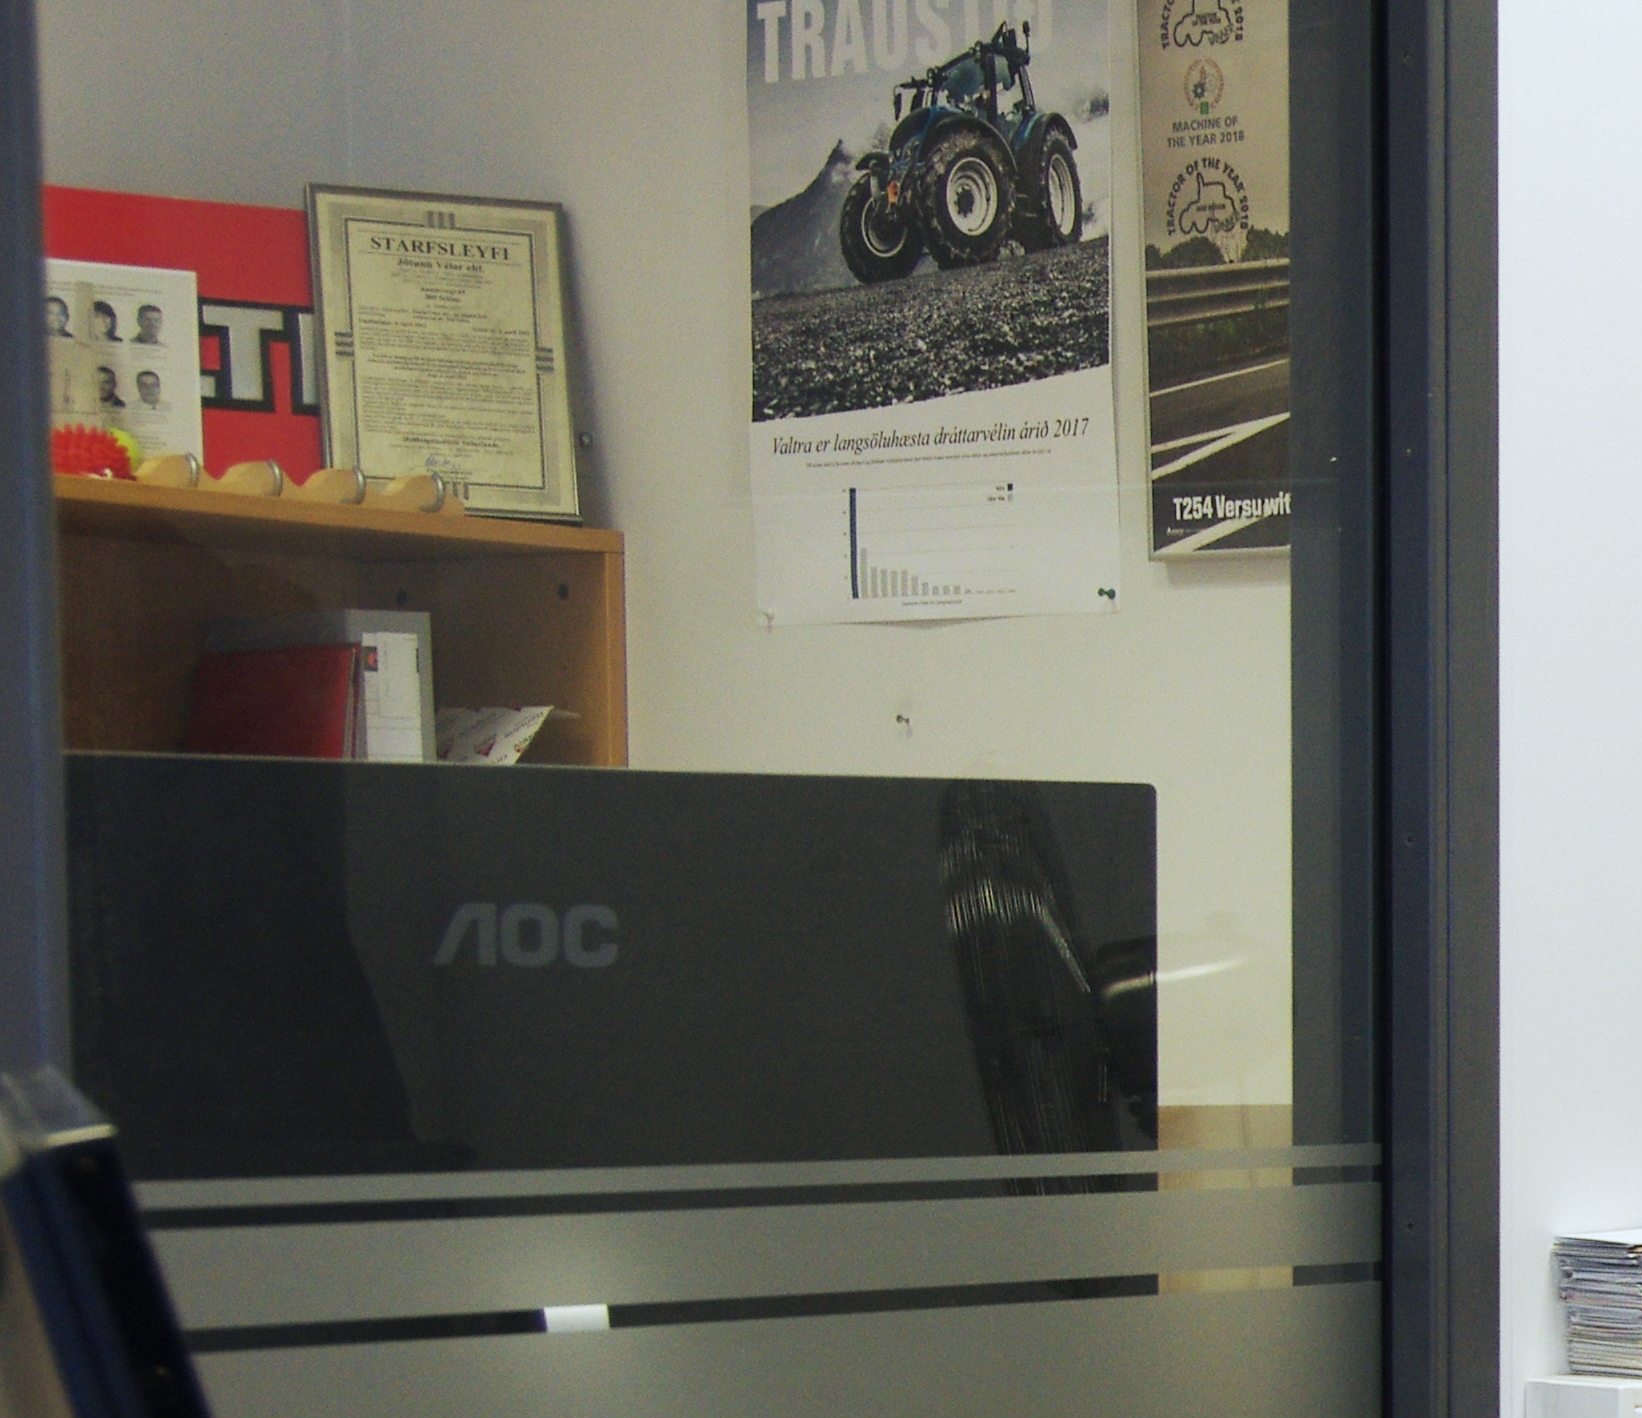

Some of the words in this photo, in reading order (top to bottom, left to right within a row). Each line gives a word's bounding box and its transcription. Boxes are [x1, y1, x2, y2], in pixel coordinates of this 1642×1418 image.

[1172, 118, 1221, 133] MACHINE
[1224, 116, 1238, 127] OF
[1167, 137, 1187, 148] THE
[1188, 133, 1217, 146] YEAR
[1220, 130, 1245, 143] 2018
[1167, 174, 1186, 236] TRACTOR
[1186, 160, 1199, 176] OF
[1202, 157, 1220, 170] THE
[1223, 162, 1245, 193] YEAR
[1240, 195, 1249, 229] 2018
[371, 236, 510, 261] STARFSLEYFI
[773, 437, 812, 454] Valtra
[816, 442, 831, 453] er
[834, 429, 930, 455] langsöluhæsta
[934, 427, 1016, 446] dráttarvélin
[1019, 421, 1049, 440] árið
[1053, 417, 1091, 438] 2017
[1173, 495, 1214, 520] T254
[1215, 494, 1263, 518] Versu
[433, 902, 620, 968] AOC
